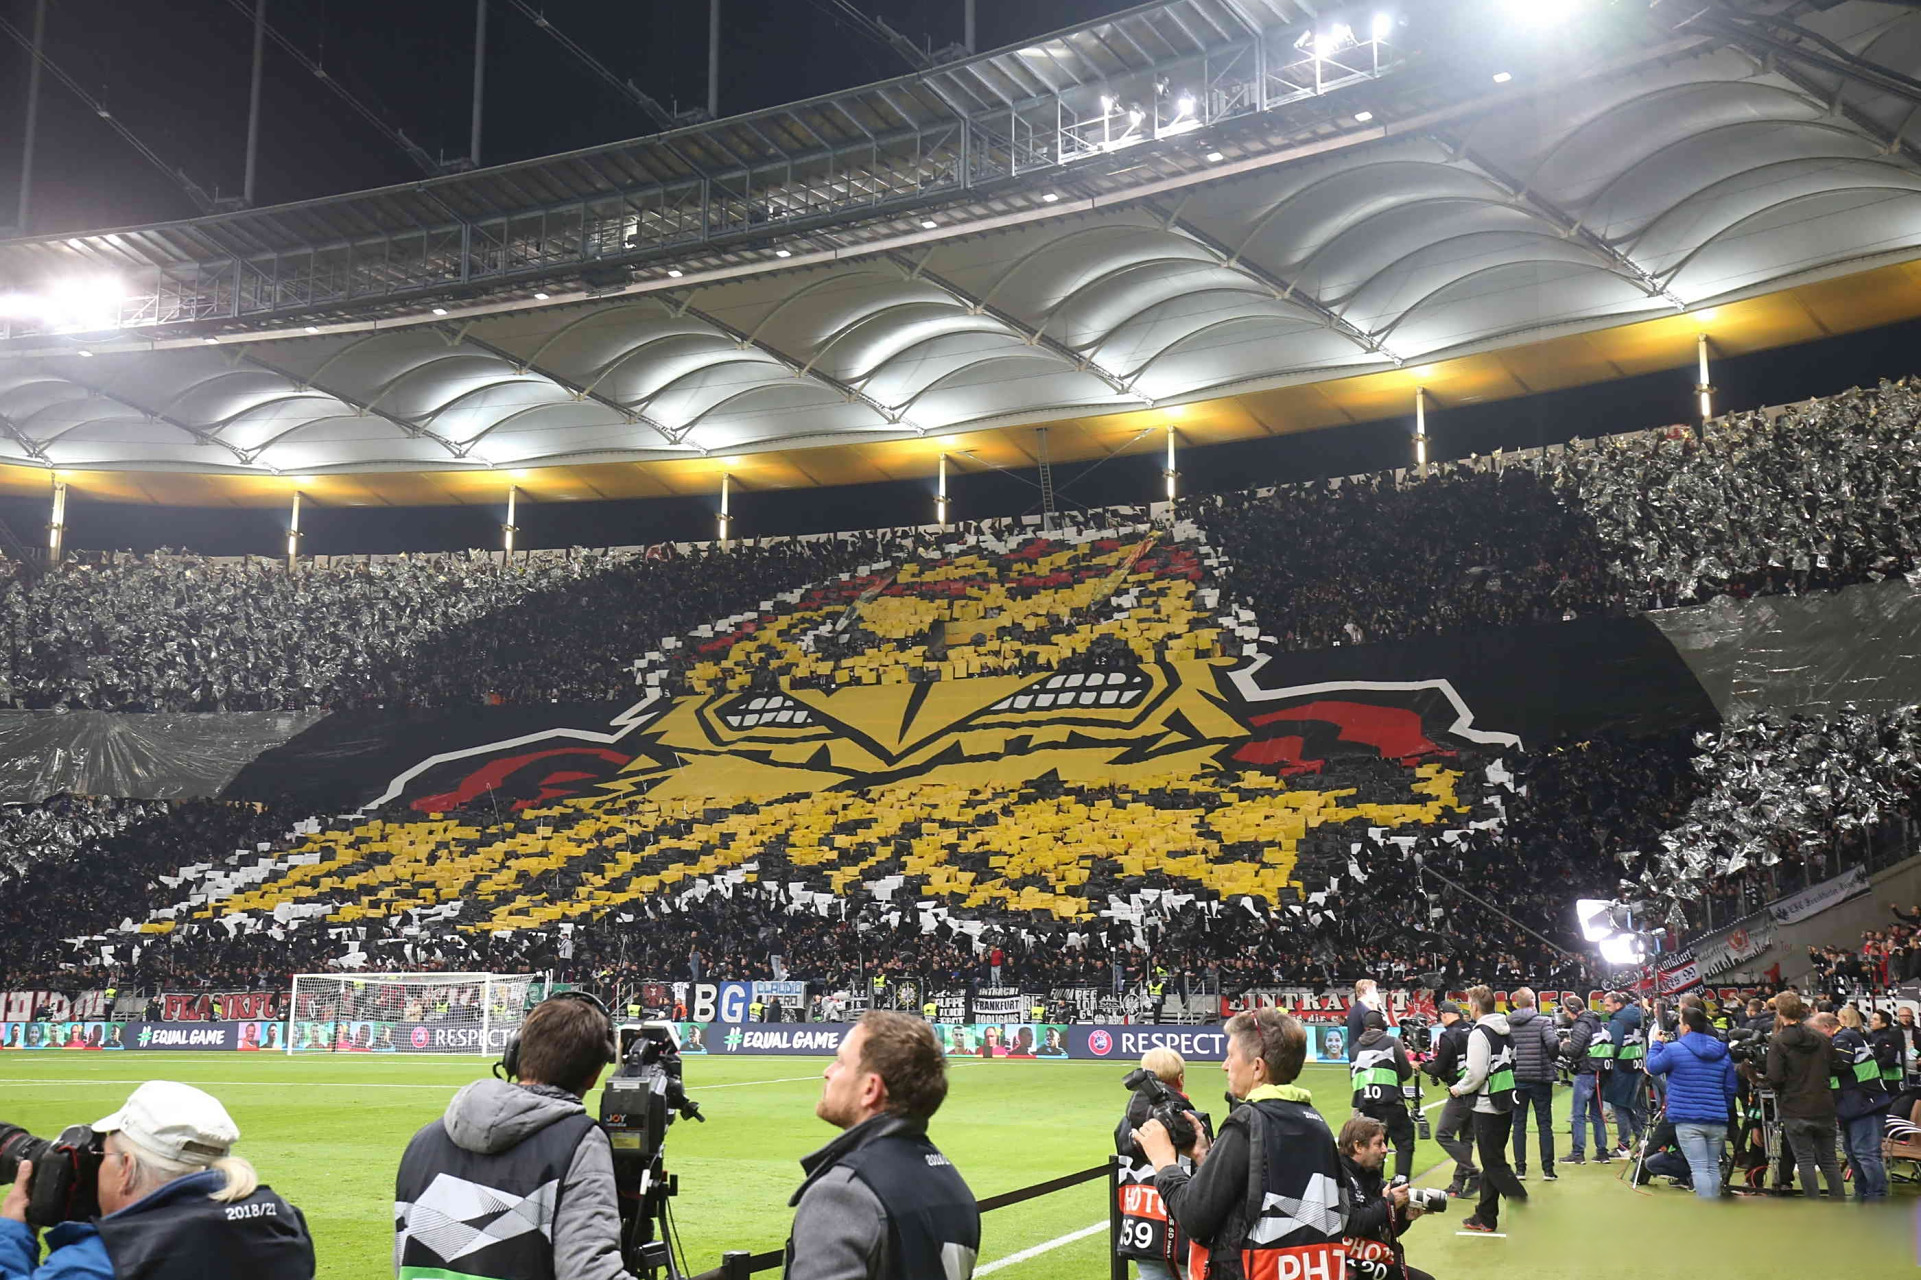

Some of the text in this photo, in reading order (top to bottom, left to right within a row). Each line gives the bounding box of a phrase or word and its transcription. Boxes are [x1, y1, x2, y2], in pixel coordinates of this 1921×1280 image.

[975, 1000, 1020, 1011] FRANKFURT
[1079, 1010, 1094, 1020] 64
[436, 1029, 508, 1047] RESPECT
[1122, 1033, 1225, 1055] RESPECT
[1363, 1084, 1382, 1099] 10
[605, 1114, 627, 1123] JOY
[225, 1202, 278, 1221] 2018/21
